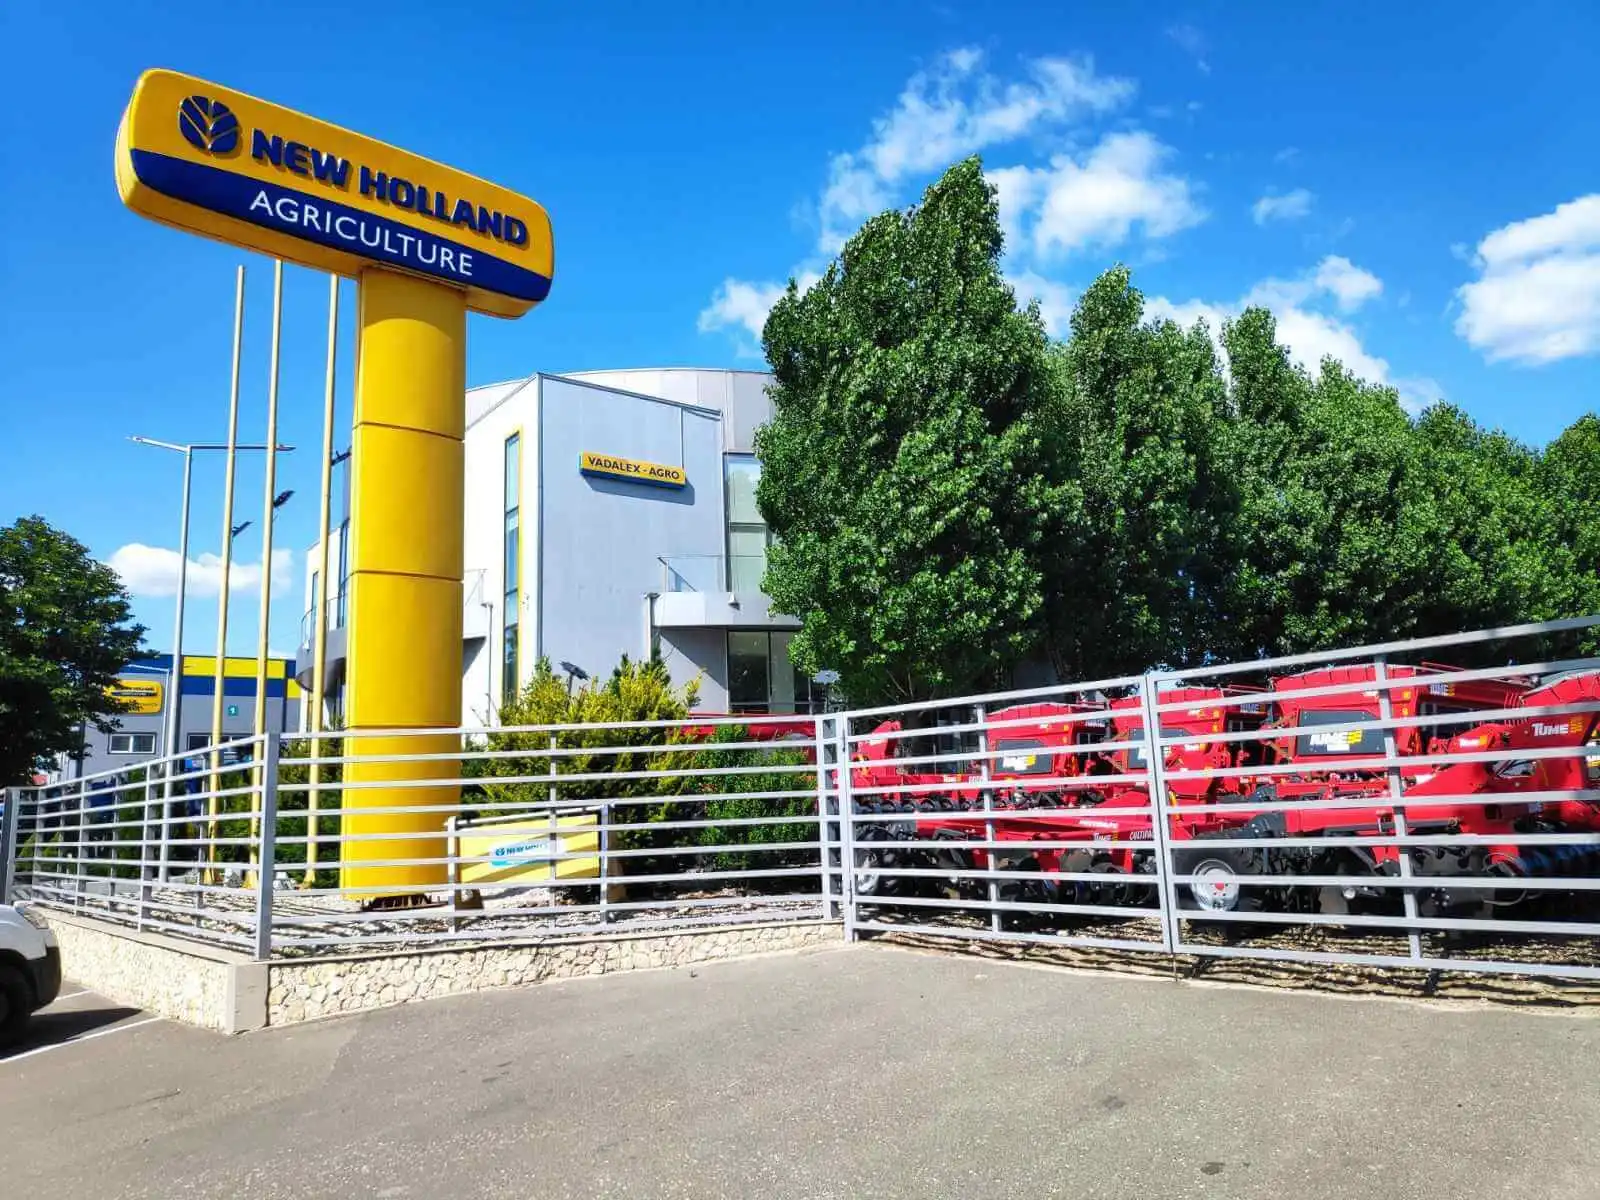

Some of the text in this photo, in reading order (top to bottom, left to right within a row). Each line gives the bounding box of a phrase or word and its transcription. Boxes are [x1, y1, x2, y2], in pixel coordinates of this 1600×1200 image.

[251, 127, 528, 244] NEW HOLLAND
[250, 190, 473, 277] AGRICULTURE
[588, 456, 640, 472] VADALEX
[649, 467, 680, 480] AGRO
